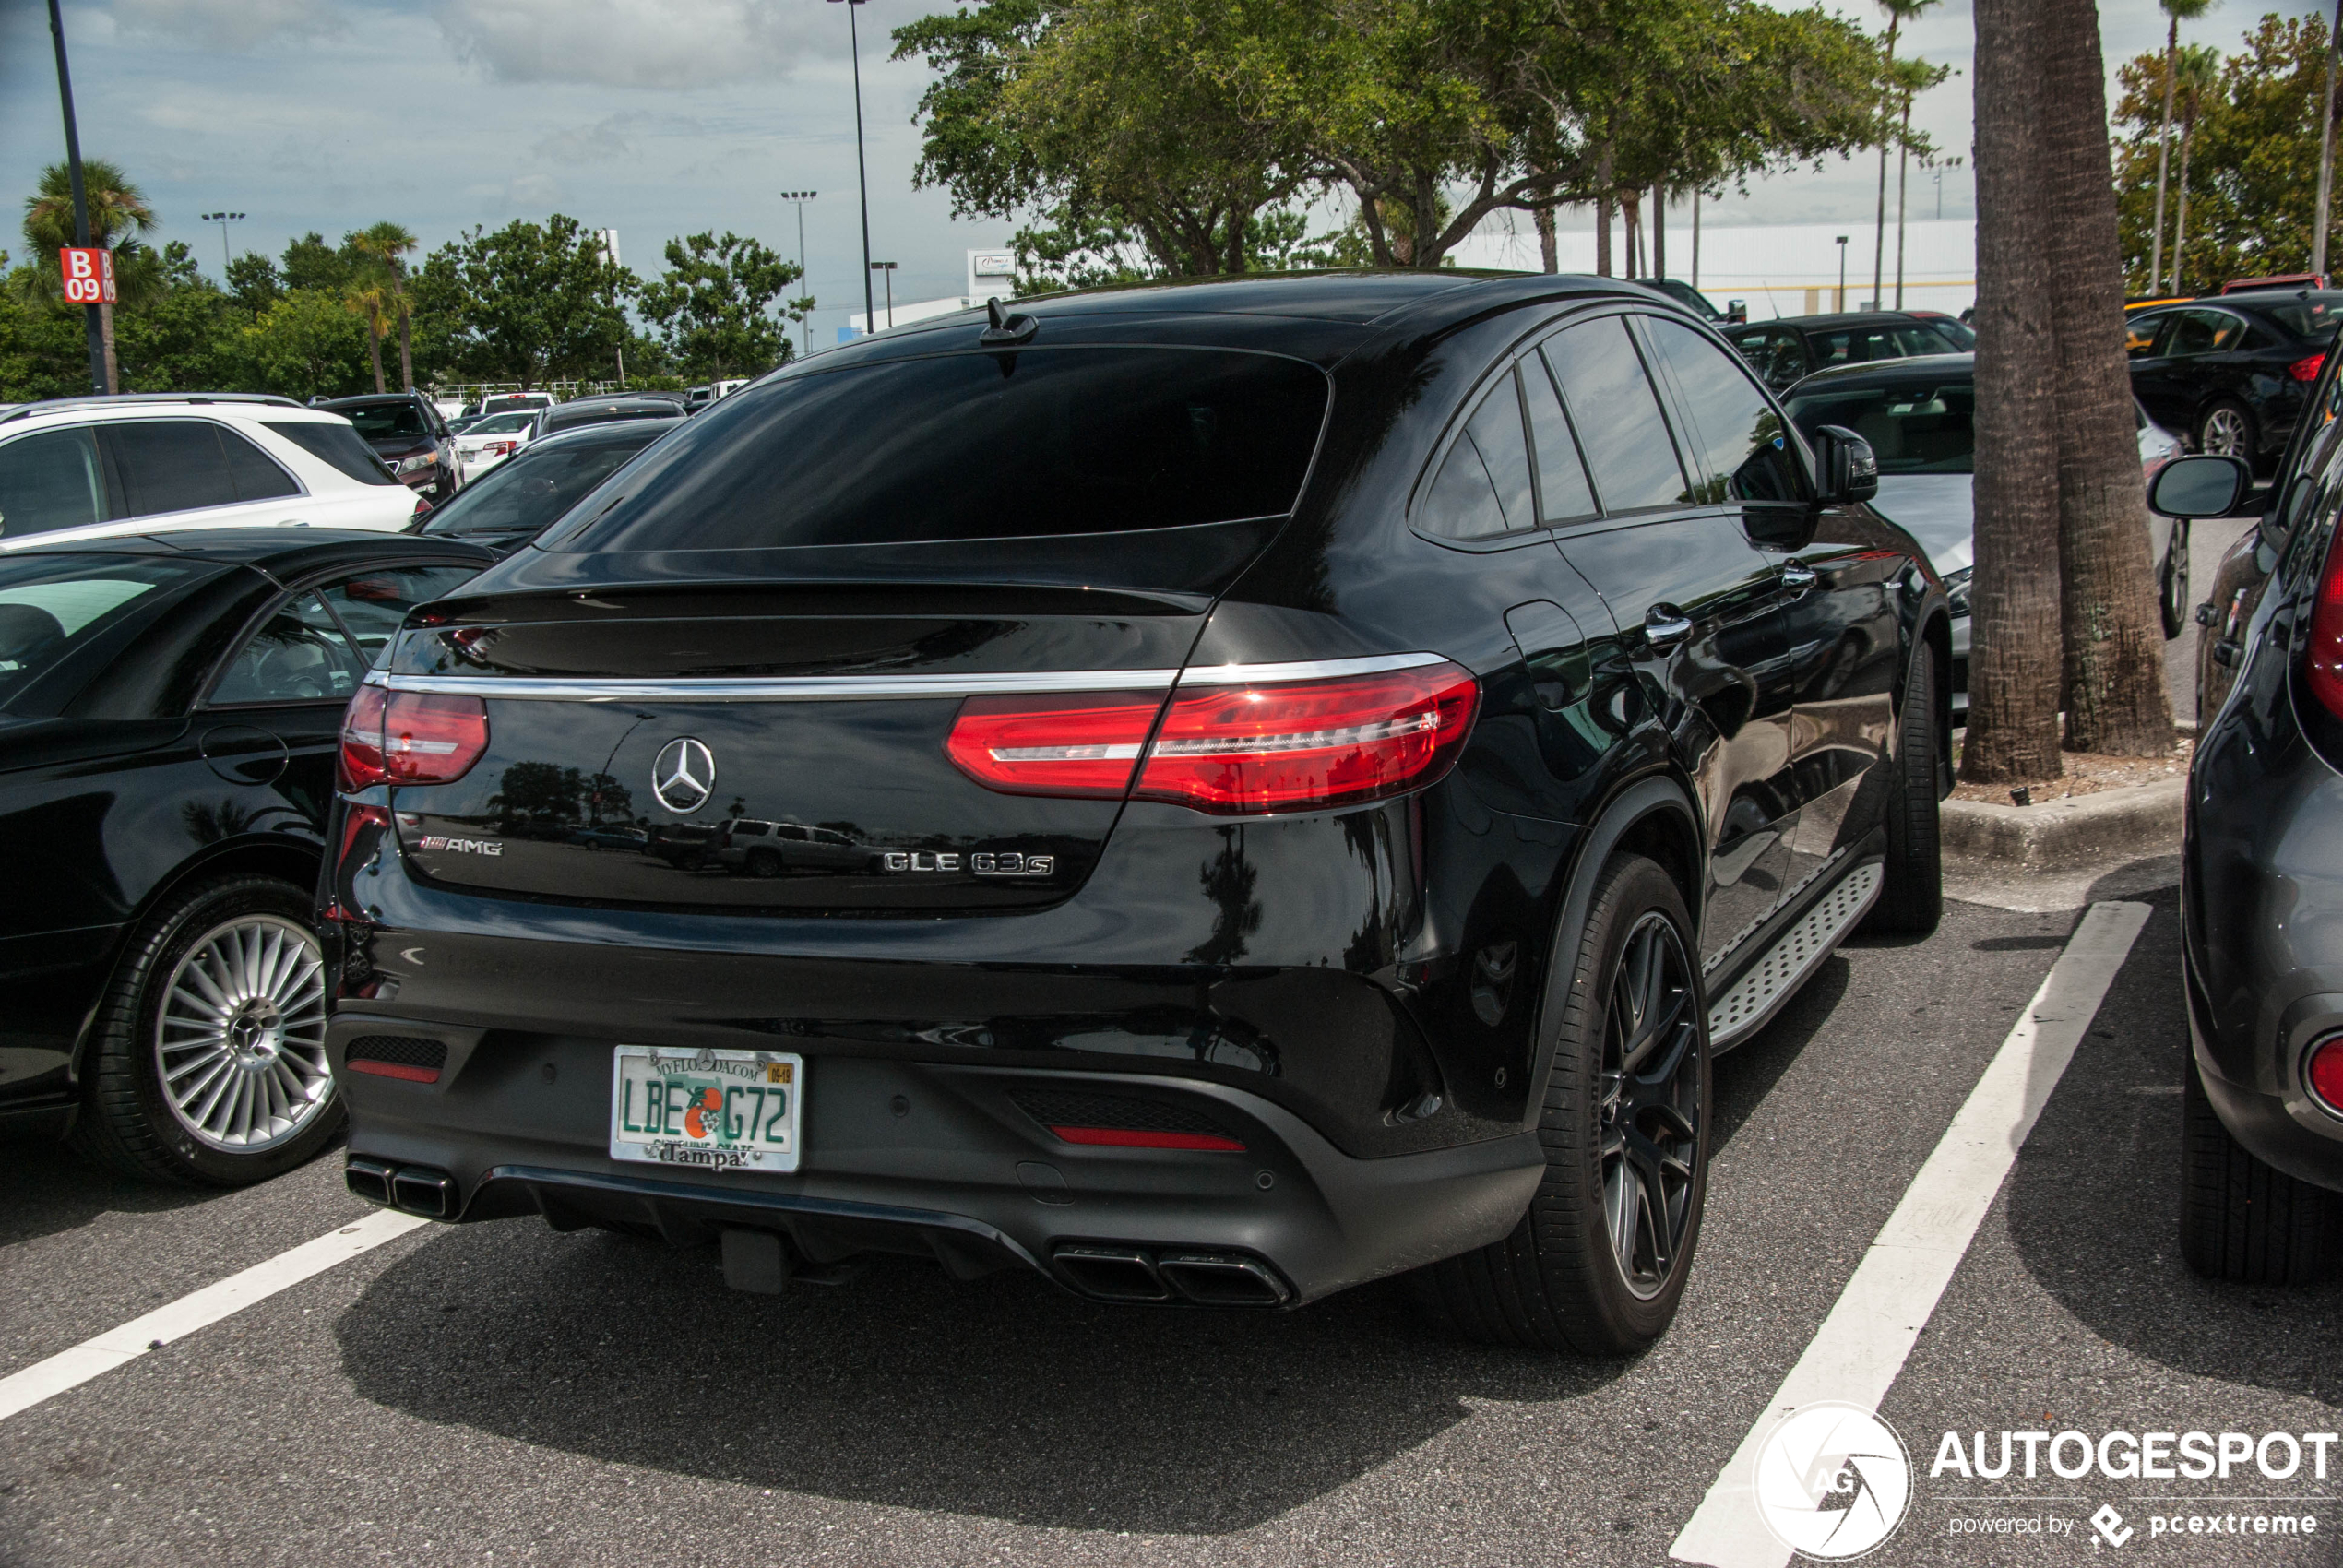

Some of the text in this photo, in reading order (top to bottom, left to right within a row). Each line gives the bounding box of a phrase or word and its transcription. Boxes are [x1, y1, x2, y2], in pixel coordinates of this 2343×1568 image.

[70, 251, 92, 278] B
[101, 252, 113, 279] B
[67, 279, 100, 301] 09
[102, 279, 117, 302] 09
[443, 838, 503, 856] AMG
[884, 852, 960, 872] GLE
[656, 1060, 758, 1082] MYFLODA.COM
[624, 1078, 787, 1143] LBE G72
